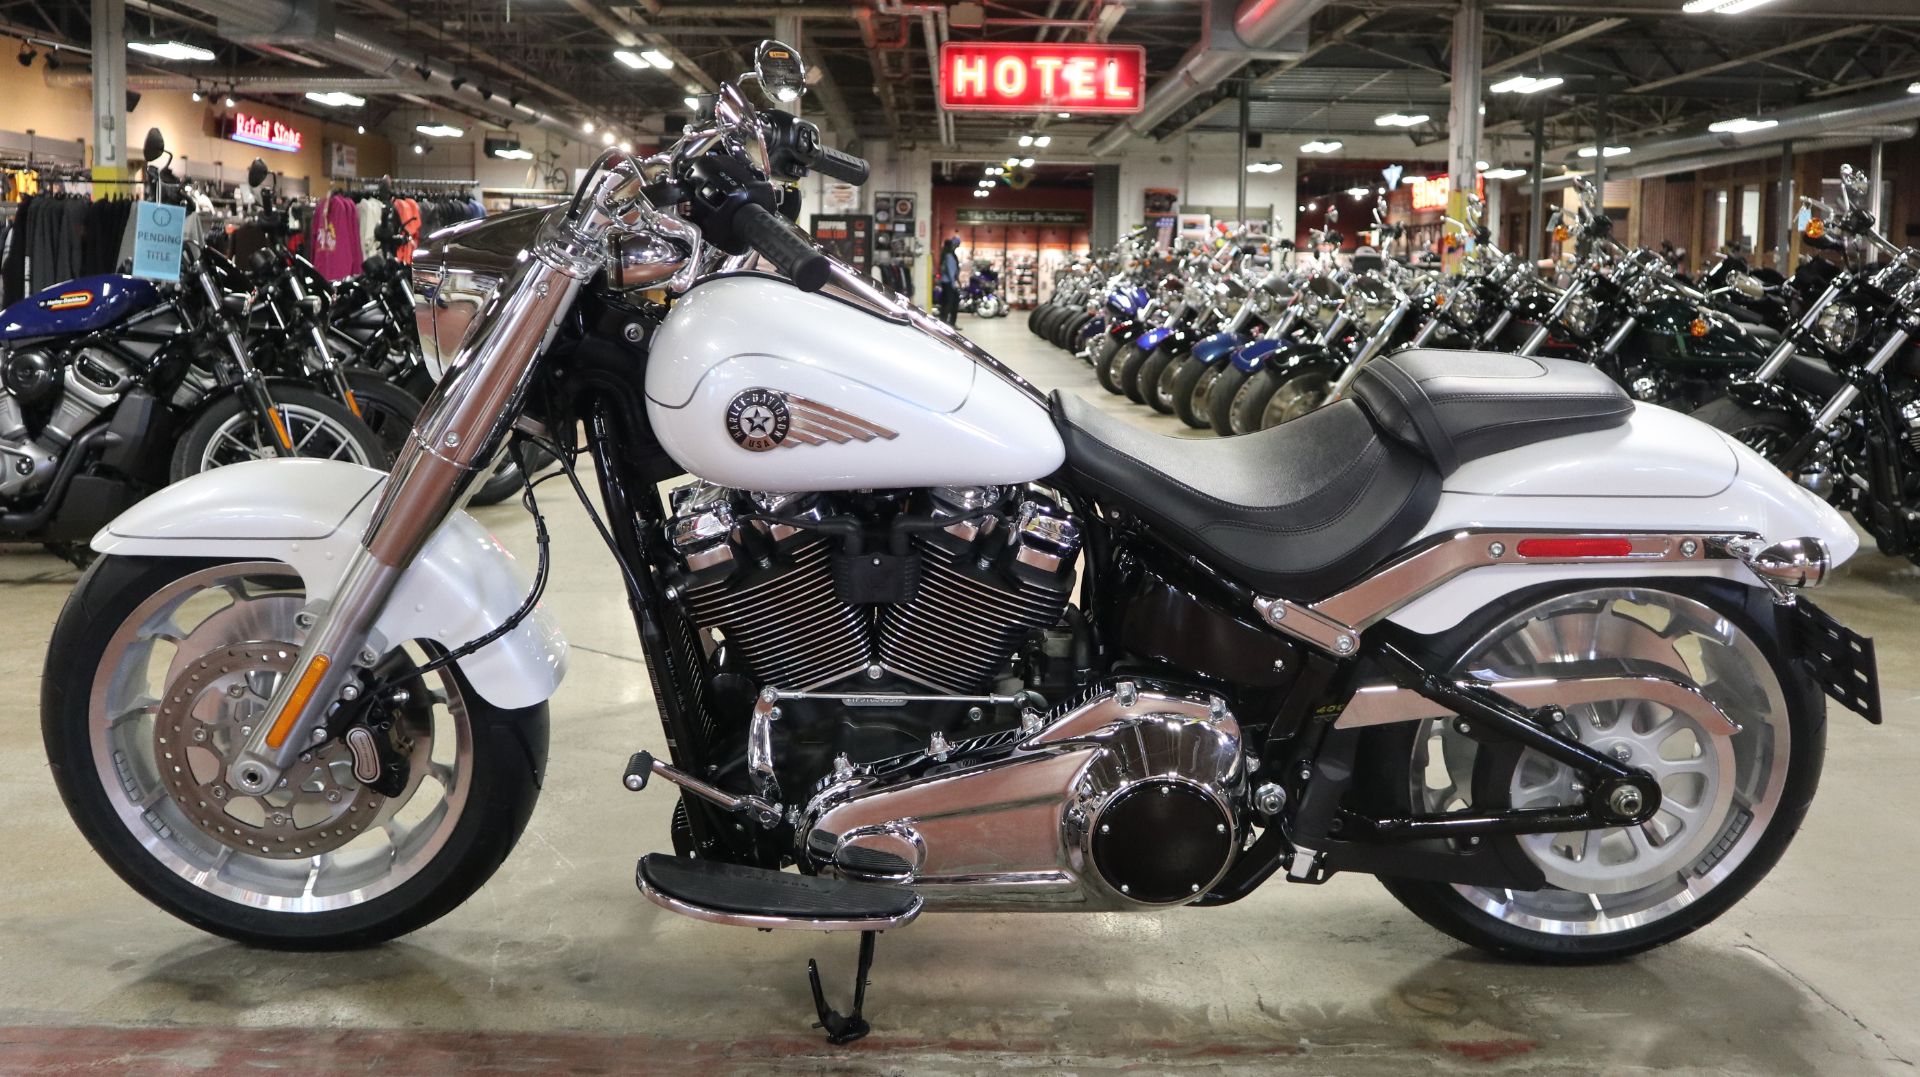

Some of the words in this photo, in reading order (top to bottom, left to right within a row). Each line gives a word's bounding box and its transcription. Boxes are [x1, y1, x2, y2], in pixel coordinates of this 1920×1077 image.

[953, 54, 1134, 100] HOTEL
[235, 112, 271, 141] Retail
[271, 121, 302, 148] Store
[137, 231, 182, 246] PENDING
[146, 250, 172, 262] TITLE
[748, 439, 770, 449] USA
